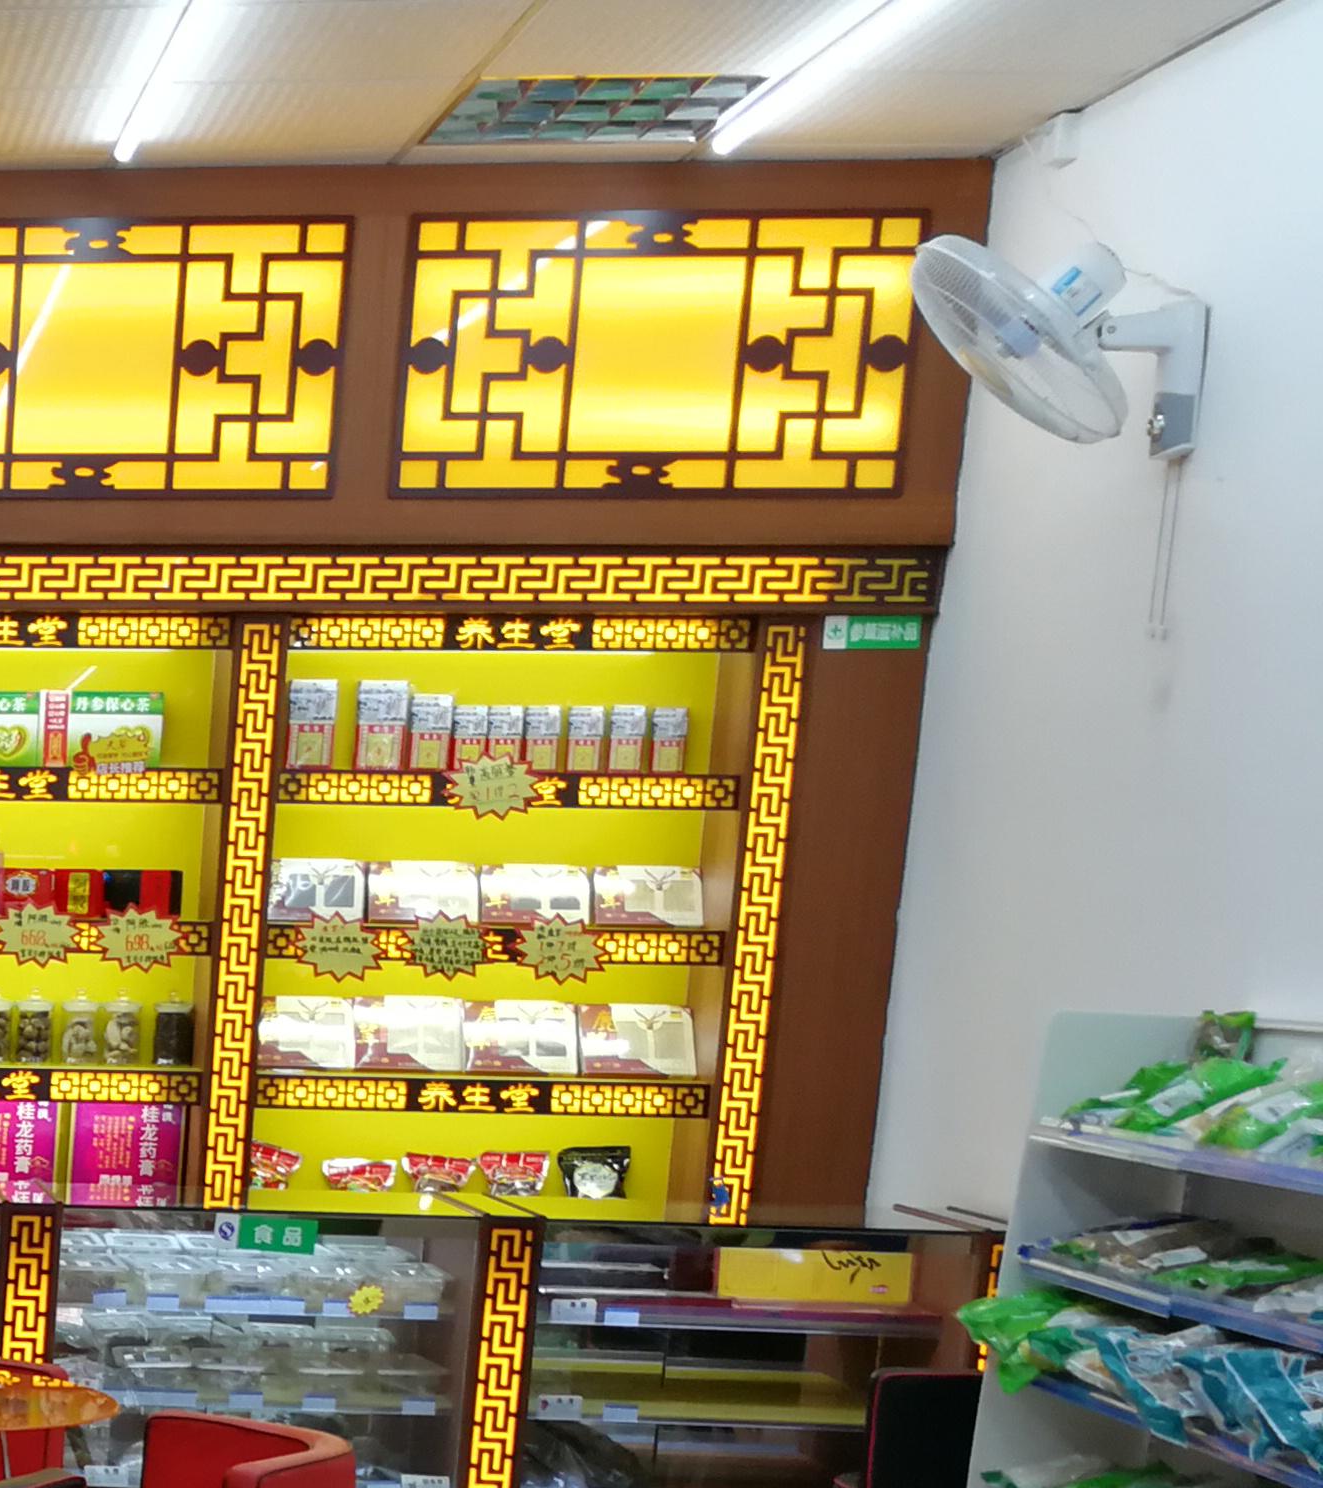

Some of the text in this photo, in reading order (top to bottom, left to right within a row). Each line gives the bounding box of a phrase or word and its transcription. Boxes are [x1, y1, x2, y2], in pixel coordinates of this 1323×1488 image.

[455, 617, 583, 650] 养生堂
[75, 695, 151, 714] 丹参保心茶
[417, 1082, 541, 1114] 养生堂
[14, 1101, 36, 1175] 桂龙药膏
[138, 1104, 160, 1178] 桂龙药膏
[254, 1222, 304, 1248] 食品
